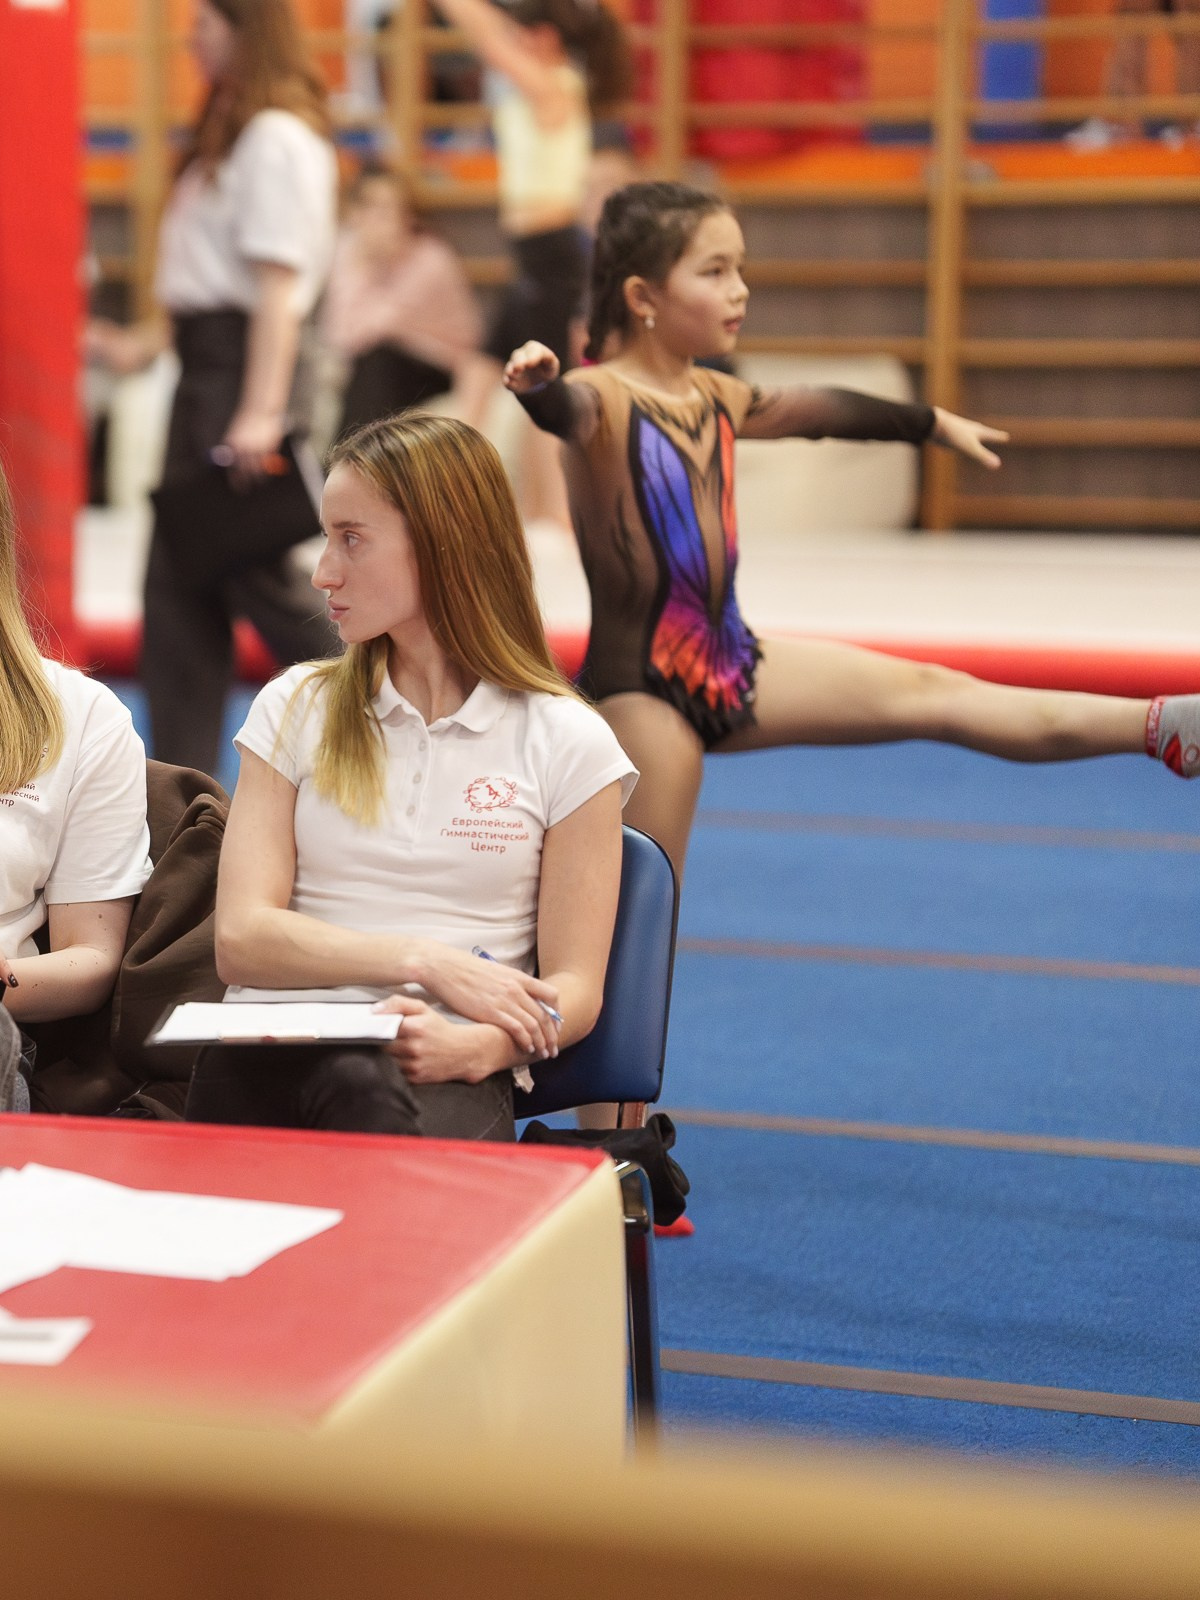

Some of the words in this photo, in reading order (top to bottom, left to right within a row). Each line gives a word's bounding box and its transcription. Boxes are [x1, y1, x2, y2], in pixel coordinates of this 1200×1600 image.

[452, 817, 523, 829] Европейский
[440, 828, 529, 840] Гимнастический
[471, 842, 506, 854] Центр
